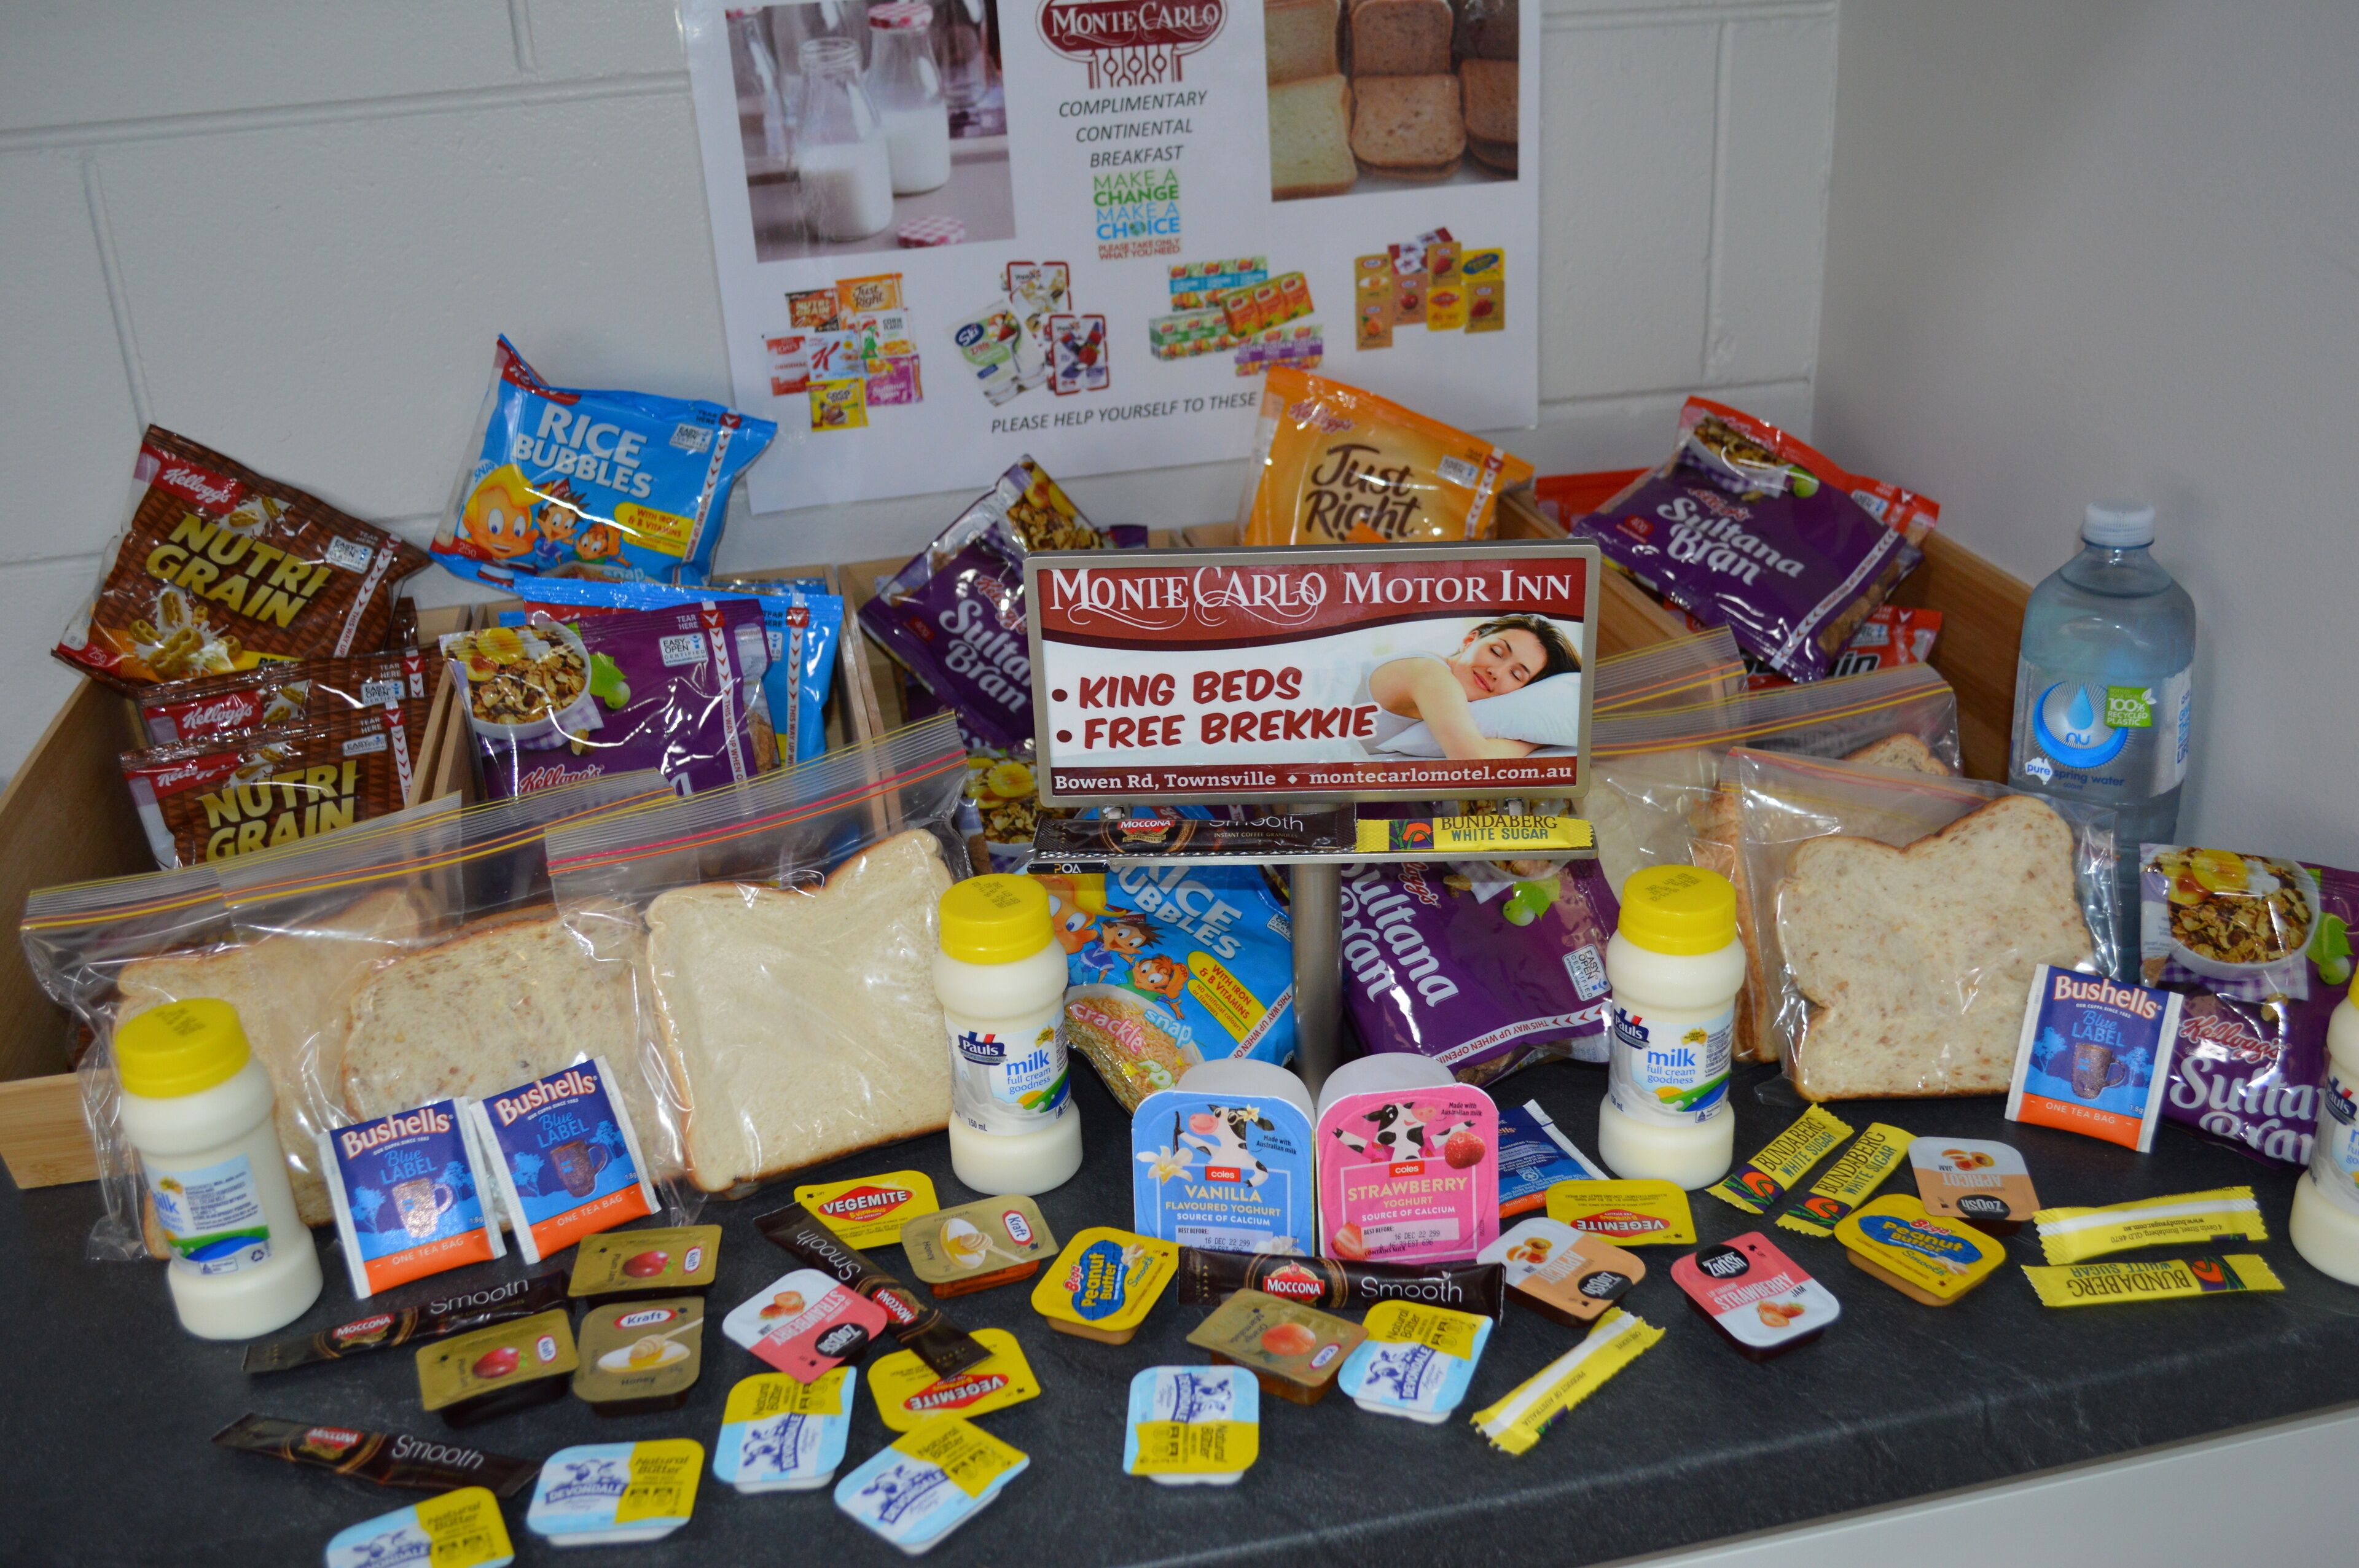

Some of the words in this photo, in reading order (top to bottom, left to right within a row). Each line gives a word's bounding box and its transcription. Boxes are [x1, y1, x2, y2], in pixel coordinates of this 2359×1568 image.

[1059, 91, 1208, 117] COMPLIMENTARY
[1076, 120, 1192, 142] CONTINENTAL
[1090, 146, 1184, 168] BREAKFAST
[1093, 170, 1156, 190] MAKE
[1163, 169, 1179, 184] A
[1093, 184, 1180, 206] CHANGE
[1097, 203, 1158, 223] MAKE
[1164, 201, 1180, 217] A
[1097, 217, 1180, 240] CHOICE
[1098, 244, 1129, 252] PLEASE
[1132, 241, 1154, 250] TAKE
[1156, 239, 1180, 248] ONLY
[1098, 251, 1127, 260] WHAT
[1129, 249, 1150, 258] YOU
[1152, 247, 1180, 256] NEED
[992, 415, 1048, 433] PLEASE
[1054, 412, 1093, 426] HELP
[1099, 400, 1178, 422] YOURSELF
[1183, 399, 1203, 412] TO
[1210, 392, 1257, 409] THESE
[536, 402, 647, 469] RICE
[511, 432, 652, 499] BUBBLES
[1311, 443, 1414, 497] Just
[163, 468, 233, 504] Kellogg's
[1657, 497, 1805, 579] Sultana
[168, 511, 331, 598] NUTRI
[1667, 523, 1763, 586] Bran
[146, 544, 307, 628] GRAIN
[1342, 571, 1489, 604] MOTOR
[1500, 569, 1571, 601] INN
[676, 615, 696, 624] TEAR
[87, 647, 108, 666] 25g
[665, 644, 690, 653] OPEN
[665, 649, 705, 660] CERTIFIED
[945, 640, 1028, 713] Bran
[1079, 673, 1175, 710] KING
[1194, 667, 1302, 704] BEDS
[182, 704, 254, 730] Kellogg's
[2108, 698, 2145, 712] 100%
[1084, 714, 1184, 749] FREE
[1201, 704, 1378, 745] BREKKIE
[2065, 732, 2090, 745] nu
[1055, 775, 1122, 790] Bowen
[1127, 774, 1159, 790] Rd,
[1165, 772, 1276, 787] Townsville
[1310, 766, 1571, 786] montecarlomotel.com.au
[2027, 763, 2051, 776] pure
[2054, 770, 2087, 784] spring
[2091, 775, 2125, 787] water
[195, 760, 361, 829] NUTRI
[206, 797, 355, 862] GRAIN
[1121, 819, 1172, 829] MOCCONA
[1441, 815, 1557, 830] BUNDABERG
[1452, 829, 1495, 841] WHITE
[1501, 828, 1548, 840] SUGAR
[1111, 866, 1242, 959] UBBLES
[1212, 964, 1231, 985] WITH
[1231, 983, 1252, 1005] IRON
[1570, 955, 1593, 998] CERTIFIED
[1215, 982, 1250, 1020] VITAMINS
[2054, 975, 2158, 1020] Bushells
[1070, 1002, 1146, 1055] crackle
[1144, 1008, 1192, 1048] snap
[1512, 1023, 1535, 1035] WAY
[1536, 1020, 1549, 1029] THIS
[1615, 1015, 1642, 1039] Pauls
[2083, 1010, 2117, 1028] Blue
[1471, 1032, 1499, 1050] WHEN
[2071, 1023, 2124, 1047] LABEL
[2180, 1016, 2281, 1063] Kellogg's
[963, 1039, 998, 1056] Pauls
[1647, 1048, 1696, 1067] milk
[1006, 1050, 1050, 1076] milk
[1007, 1075, 1023, 1085] full
[1025, 1067, 1050, 1082] cream
[1009, 1076, 1050, 1095] goodness
[494, 1071, 596, 1128] Bushells
[968, 1118, 977, 1129] 150
[979, 1123, 987, 1131] mL
[2046, 1102, 2067, 1113] ONE
[2071, 1108, 2091, 1118] TEA
[2094, 1113, 2114, 1124] BAG
[340, 1109, 450, 1160] Bushells
[1754, 1117, 1826, 1172] BUNDABERG
[385, 1149, 422, 1167] Blue
[1779, 1149, 1811, 1178] WHITE
[1805, 1131, 1837, 1155] SUGAR
[380, 1159, 436, 1185] LABEL
[1395, 1164, 1419, 1174] coles
[1942, 1173, 2002, 1187] APRICOT
[1184, 1185, 1262, 1203] VANILLA
[1348, 1177, 1468, 1202] STRAWBERRY
[823, 1190, 913, 1215] VEGEMITE
[1165, 1202, 1227, 1212] FLAVOURED
[1231, 1204, 1281, 1217] YOGHURT
[1362, 1211, 1397, 1222] SOURCE
[1415, 1206, 1455, 1217] CALCIUM
[1383, 1196, 1433, 1209] YOGHURT
[1008, 1215, 1027, 1238] Kraft
[1177, 1213, 1212, 1223] SOURCE
[1215, 1215, 1227, 1223] OF
[1230, 1215, 1270, 1226] CALCIUM
[1576, 1220, 1665, 1230] VEGEMITE
[1910, 1219, 1952, 1235] Bega
[1882, 1220, 1964, 1253] Peanut
[1891, 1232, 1943, 1252] Butter
[393, 1253, 415, 1265] ONE
[418, 1245, 440, 1258] TEA
[442, 1238, 464, 1250] BAG
[796, 1230, 862, 1280] Smooth
[1902, 1250, 1946, 1276] Smooth
[1081, 1253, 1104, 1309] Peanut
[1100, 1262, 1116, 1301] Butter
[1267, 1278, 1321, 1294] MOCCONA
[1361, 1277, 1463, 1303] Smooth
[1714, 1273, 1796, 1310] STRAWBERRY
[1791, 1285, 1806, 1298] JAM
[2067, 1270, 2193, 1297] BUNDABERG
[337, 1316, 392, 1336] MOCCONA
[626, 1311, 663, 1324] Kraft
[771, 1289, 846, 1346] STRAWBERRY
[620, 1375, 655, 1386] Honey
[910, 1374, 1004, 1410] VEGEMITE
[392, 1434, 485, 1470] Smooth
[635, 1455, 689, 1465] Natural
[633, 1463, 684, 1473] Butter
[548, 1482, 624, 1503] DEVONDALE
